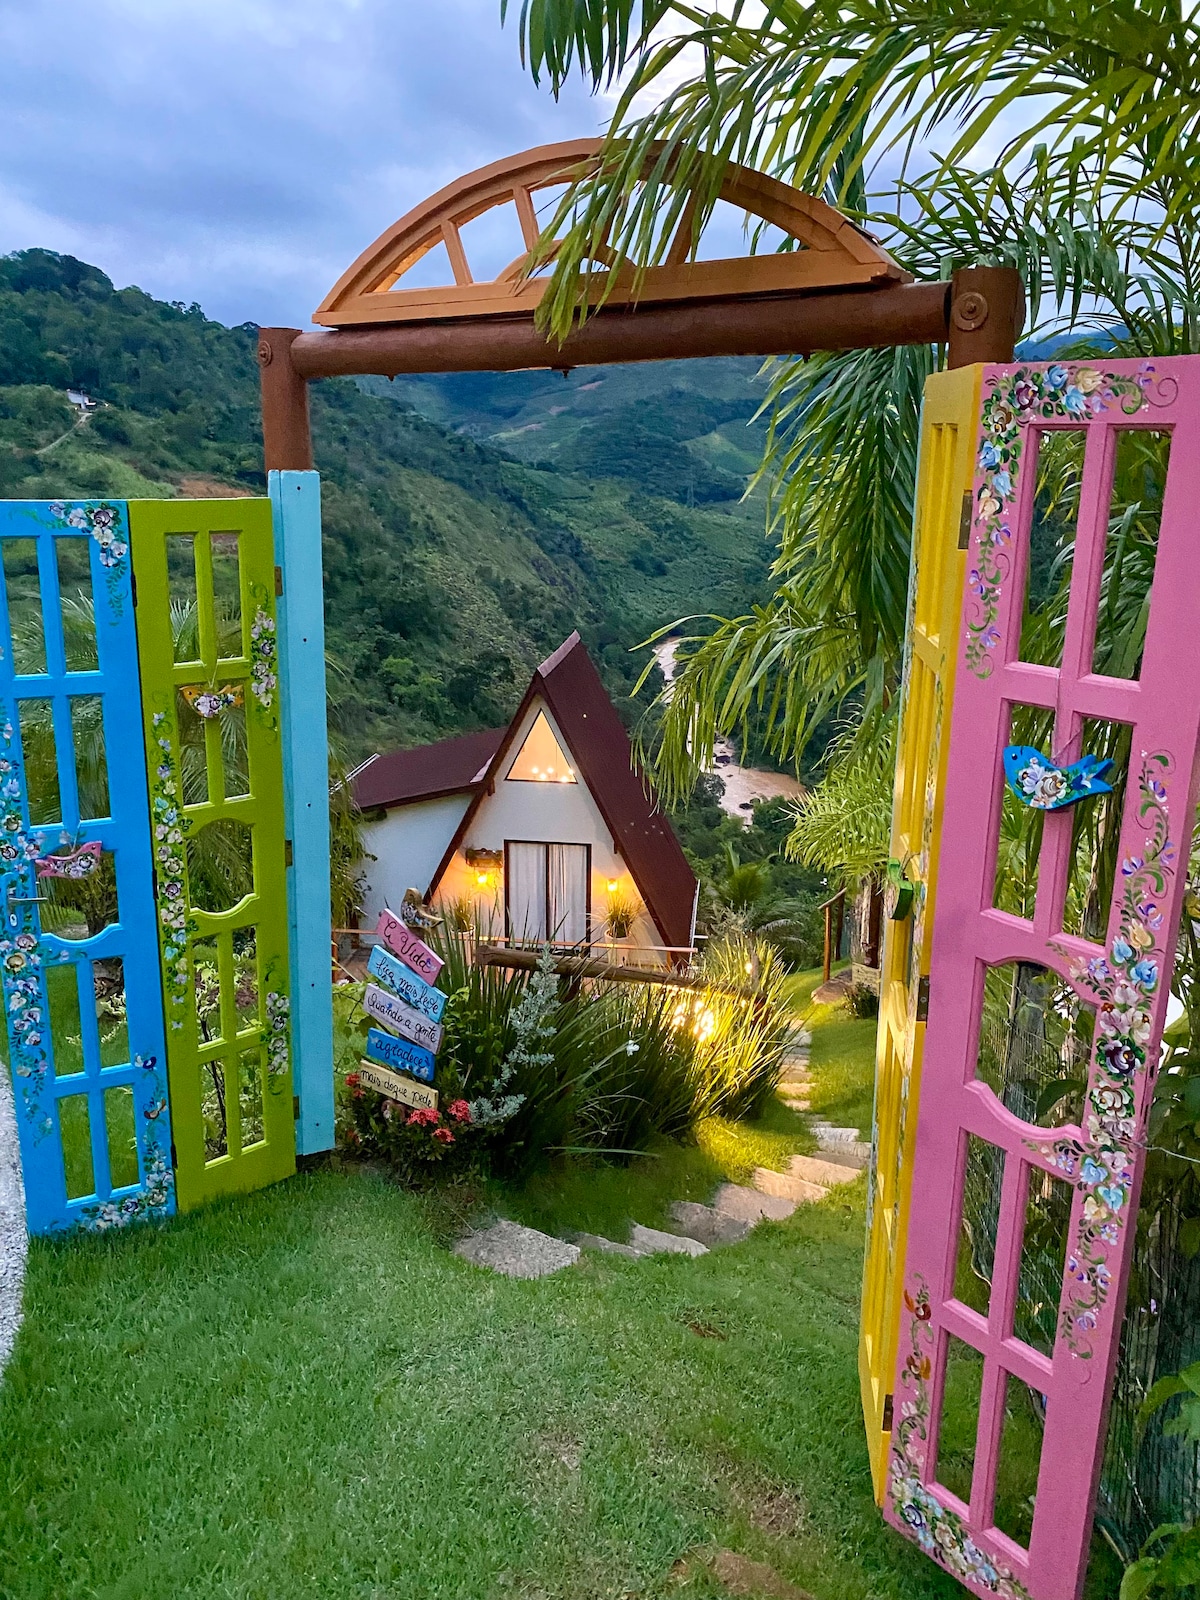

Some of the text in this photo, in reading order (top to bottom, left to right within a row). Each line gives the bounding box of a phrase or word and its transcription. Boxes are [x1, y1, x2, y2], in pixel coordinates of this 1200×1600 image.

[400, 931, 431, 974] Vida
[376, 956, 439, 1014] fica mais leve
[367, 993, 437, 1042] Quando a gente
[375, 1039, 426, 1069] agradece
[361, 1069, 381, 1086] mais
[411, 1090, 432, 1107] pede
